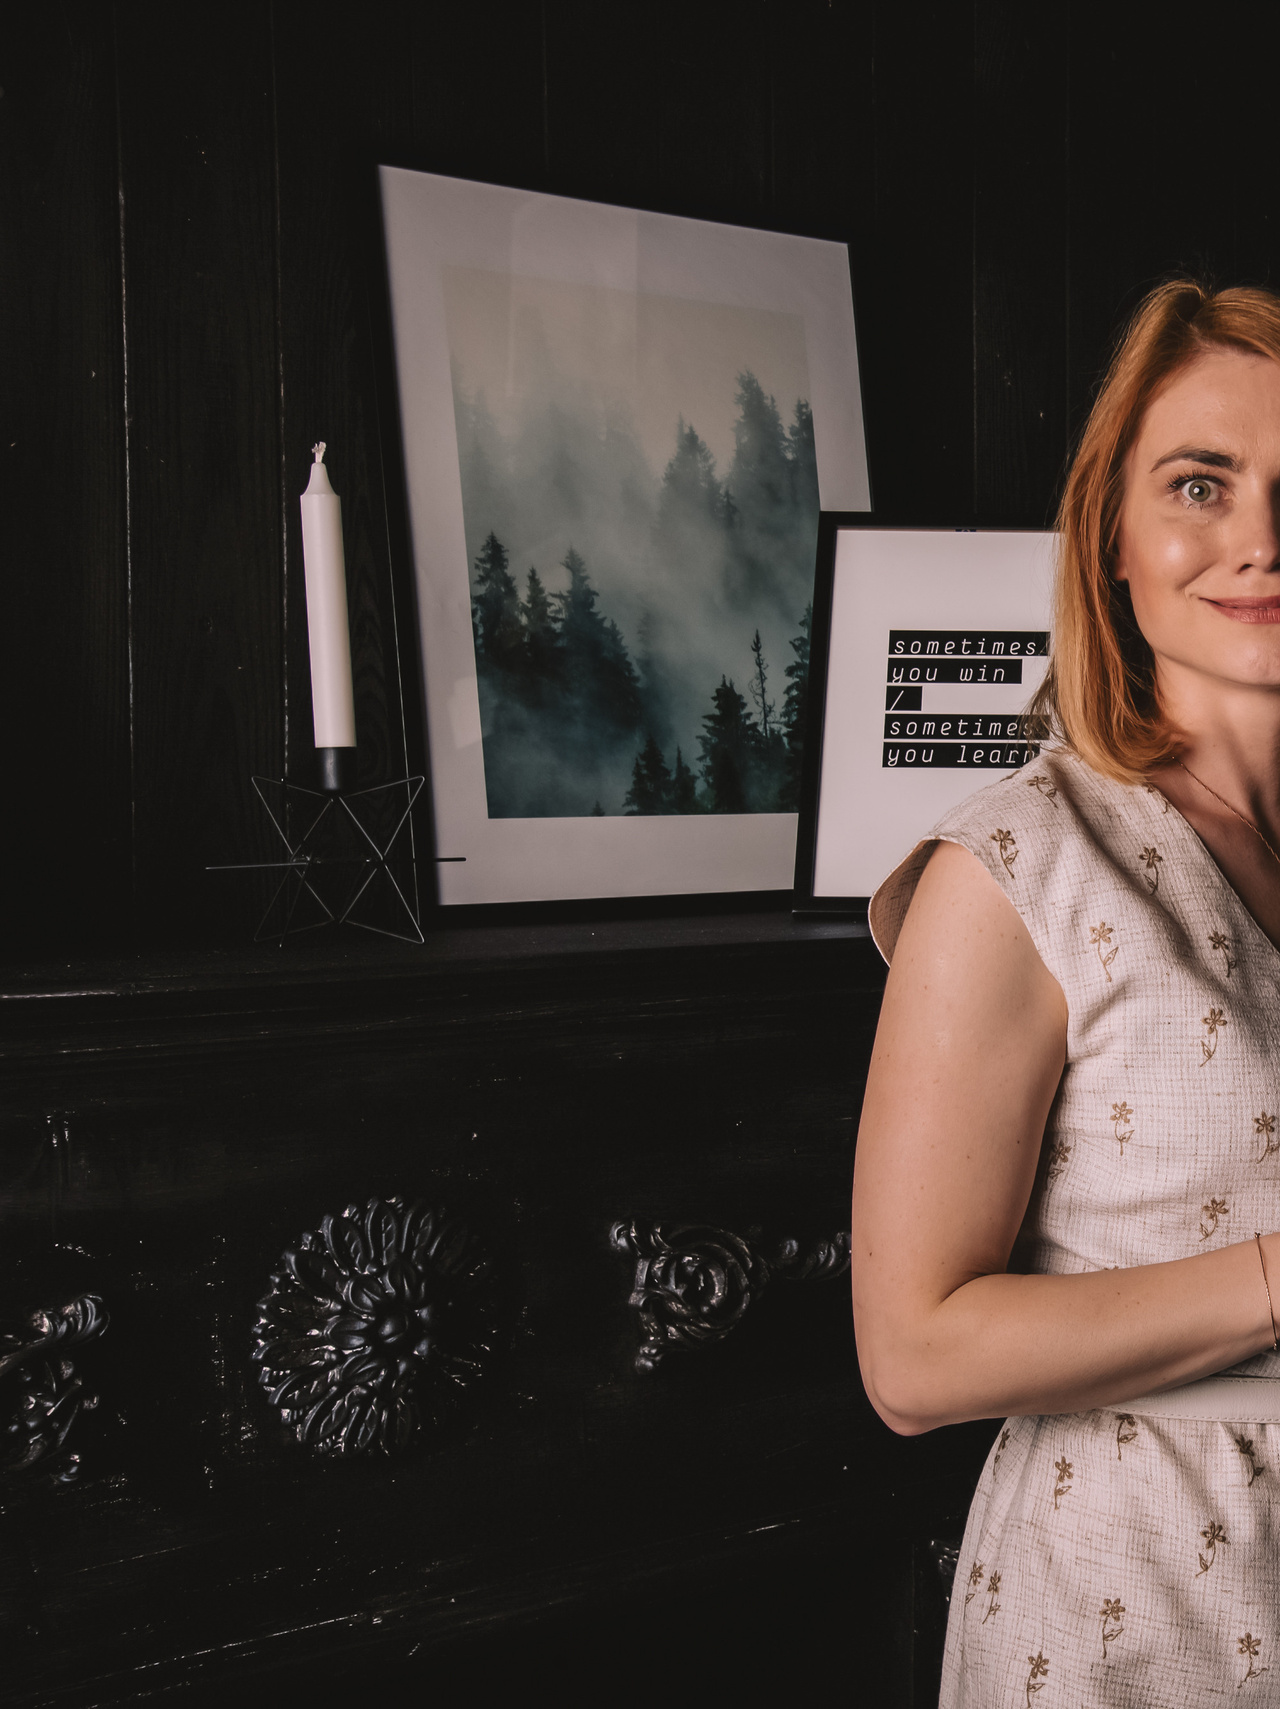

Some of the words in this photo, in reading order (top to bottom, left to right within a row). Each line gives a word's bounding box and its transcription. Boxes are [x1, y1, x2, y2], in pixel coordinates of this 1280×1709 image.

[893, 638, 1037, 655] sometimes
[891, 667, 939, 684] you
[959, 664, 1006, 682] win
[887, 748, 935, 767] you
